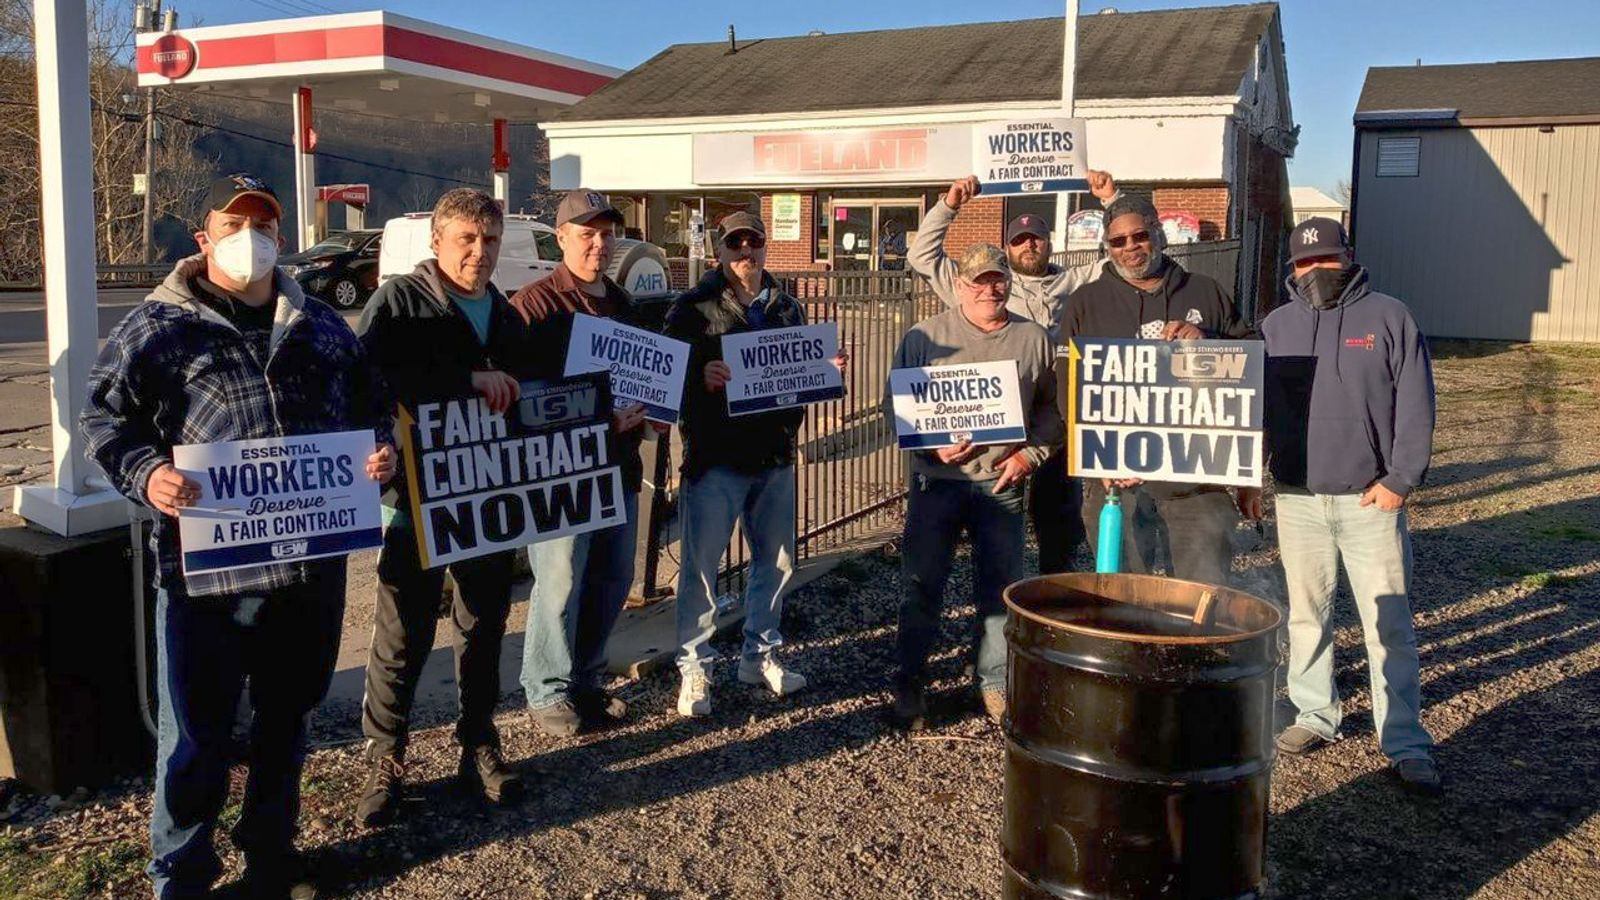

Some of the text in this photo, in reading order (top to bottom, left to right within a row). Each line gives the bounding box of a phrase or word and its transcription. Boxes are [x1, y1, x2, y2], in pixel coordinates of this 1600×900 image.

[1007, 122, 1054, 132] ESSENTIAL
[759, 136, 928, 173] FUELAND
[989, 131, 1073, 155] WORKERS
[1008, 153, 1055, 166] Deserve
[989, 164, 1074, 180] A FAIR CONTRACT
[634, 273, 663, 292] AIR
[613, 328, 658, 348] ESSENTIAL
[758, 332, 804, 344] ESSENTIAL
[591, 333, 673, 376] WORKERS
[740, 338, 824, 369] WORKERS
[1082, 344, 1157, 384] FAIR
[609, 362, 653, 384] Deserve
[761, 365, 808, 379] Deserve
[930, 368, 980, 379] ESSENTIAL
[1171, 353, 1248, 379] USW
[620, 379, 668, 404] CONTRACT
[744, 373, 826, 397] A FAIR CONTRACT
[910, 376, 1003, 404] WORKERS
[519, 387, 597, 427] USW
[934, 402, 984, 415] Deserve
[1081, 384, 1256, 428] CONTRACT
[914, 412, 1006, 431] A FAIR CONTRACT
[241, 443, 320, 460] ESSENTIAL
[422, 422, 609, 499] CONTRACT
[1081, 429, 1255, 478] NOW!
[208, 454, 354, 500] WORKERS
[245, 495, 326, 516] Deserve
[429, 473, 617, 557] NOW!
[213, 507, 357, 544] A FAIR CONTRACT
[270, 538, 309, 559] USW
